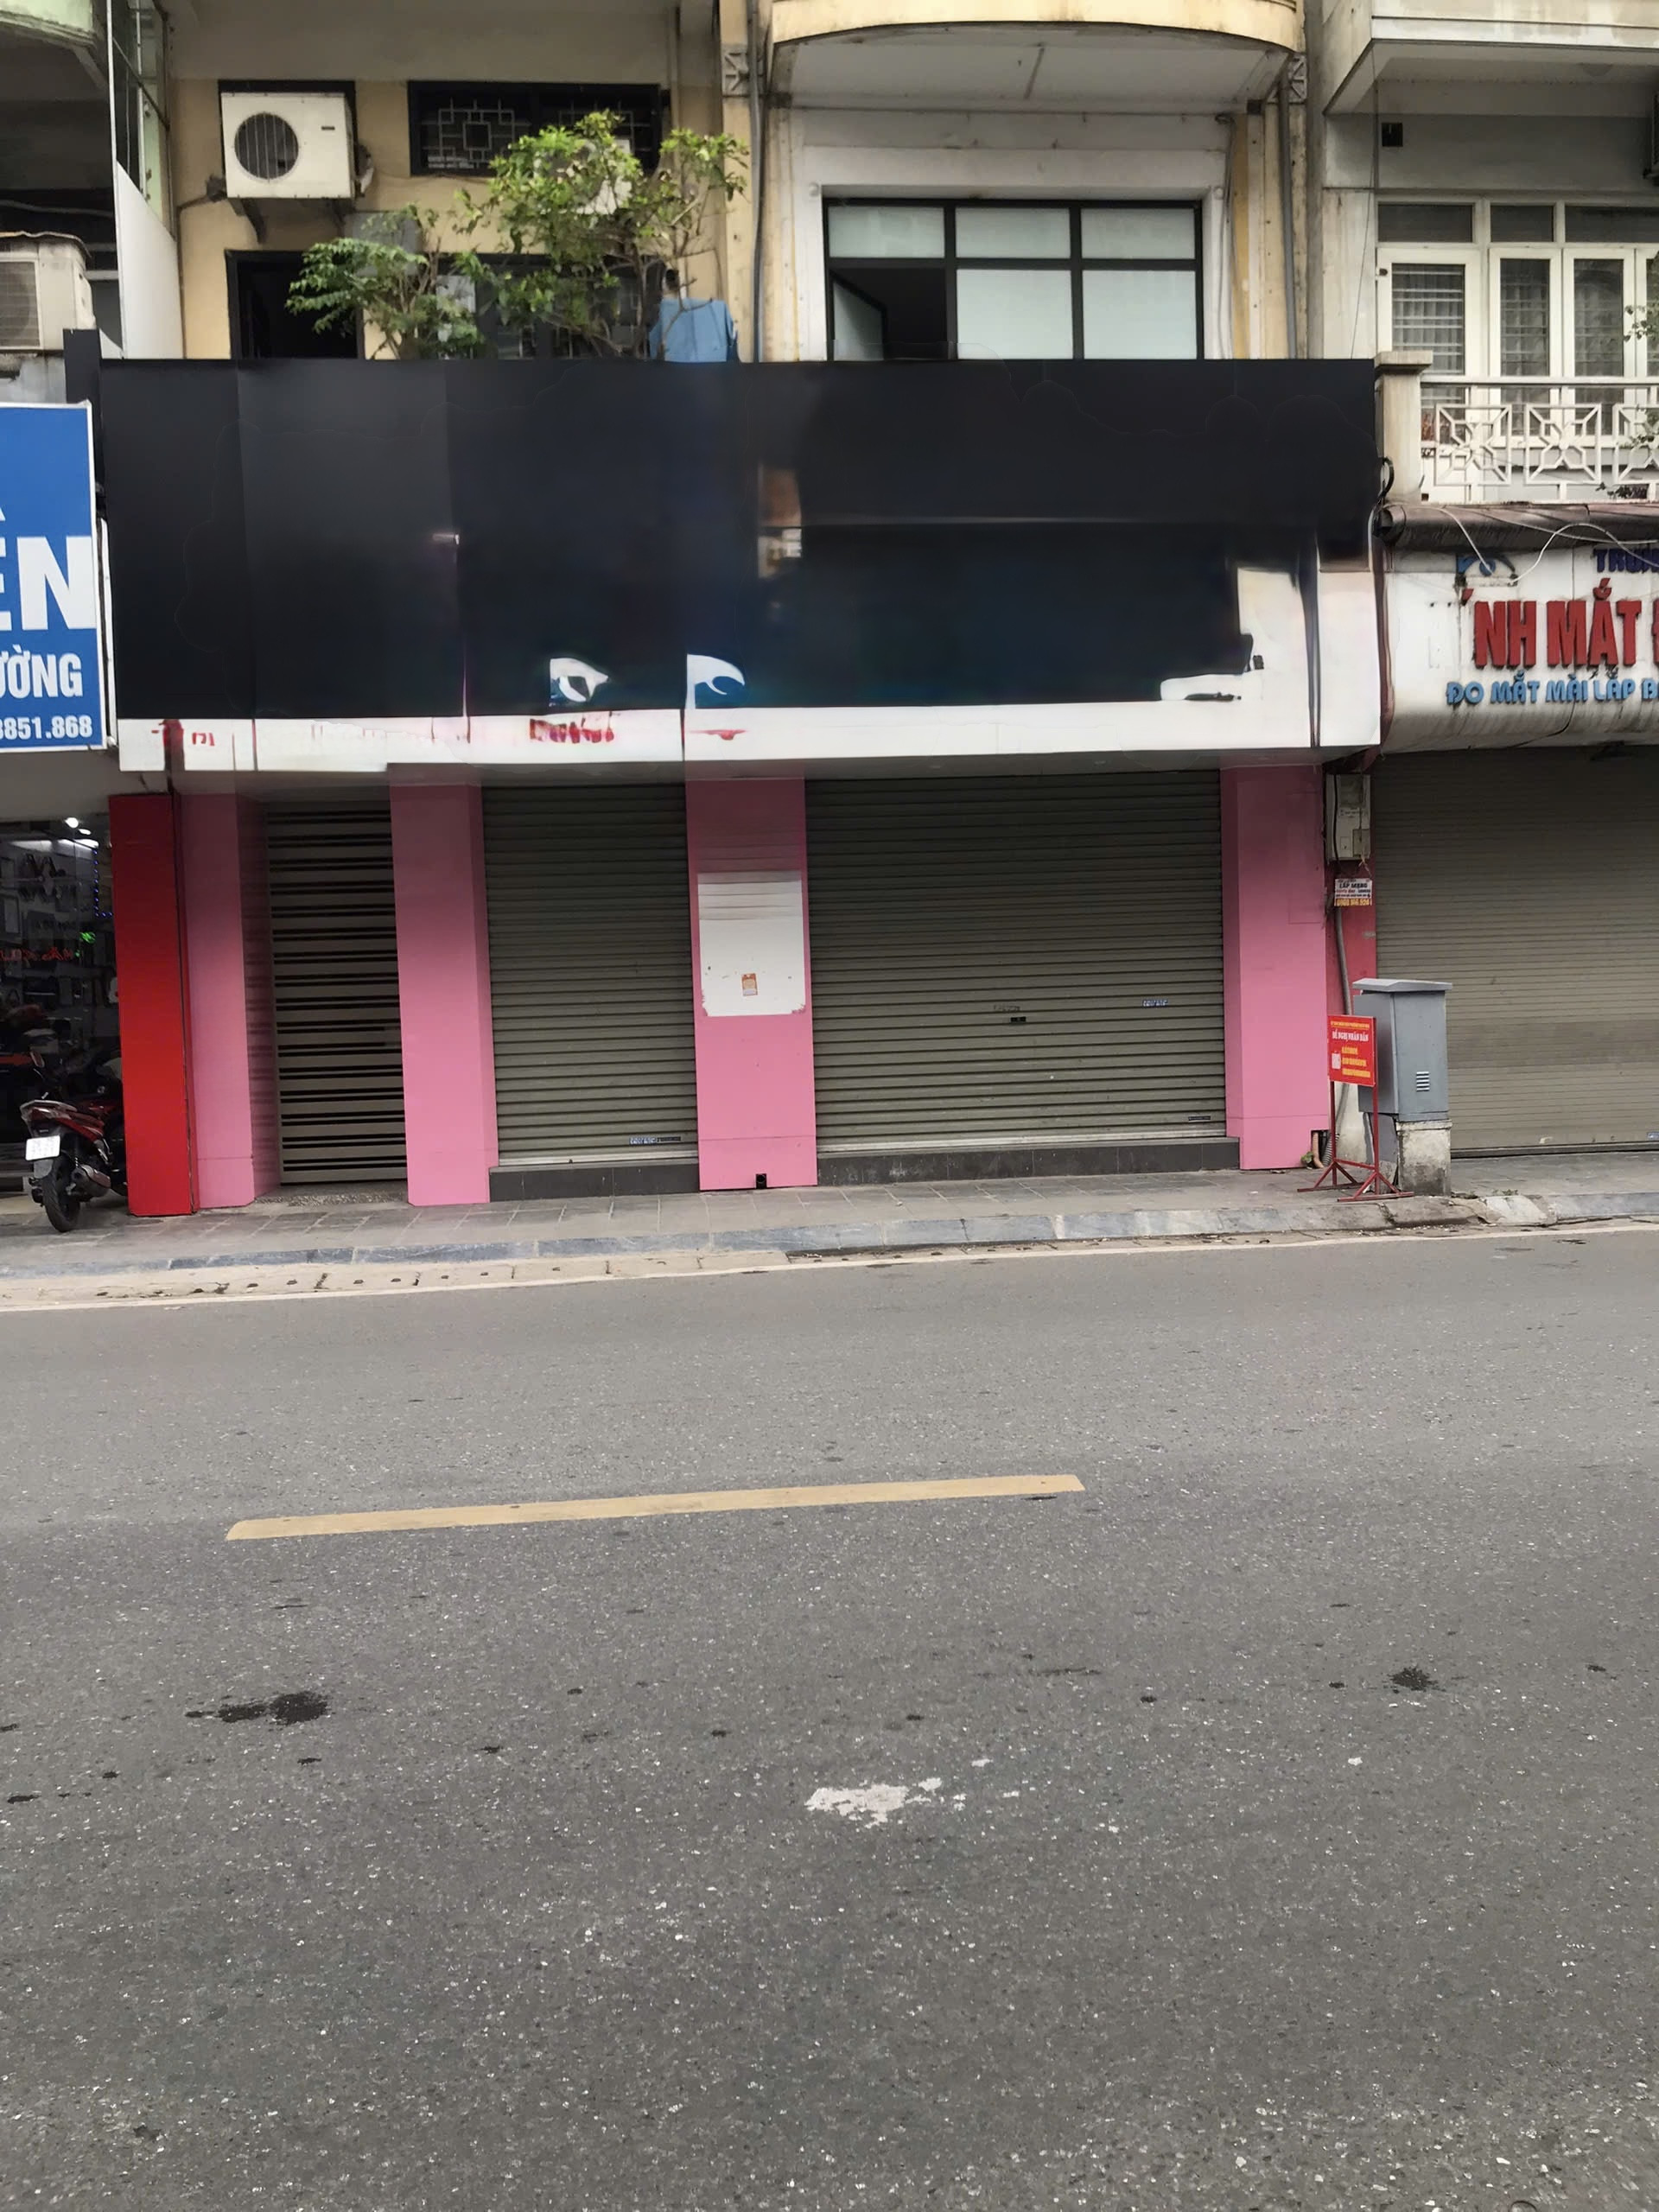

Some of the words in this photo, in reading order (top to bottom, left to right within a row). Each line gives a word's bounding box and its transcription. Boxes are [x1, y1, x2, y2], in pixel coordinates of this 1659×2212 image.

[0, 537, 96, 631] N
[1547, 577, 1643, 668] MẮT
[1446, 682, 1484, 705] ĐO
[1491, 670, 1541, 704] MẮT
